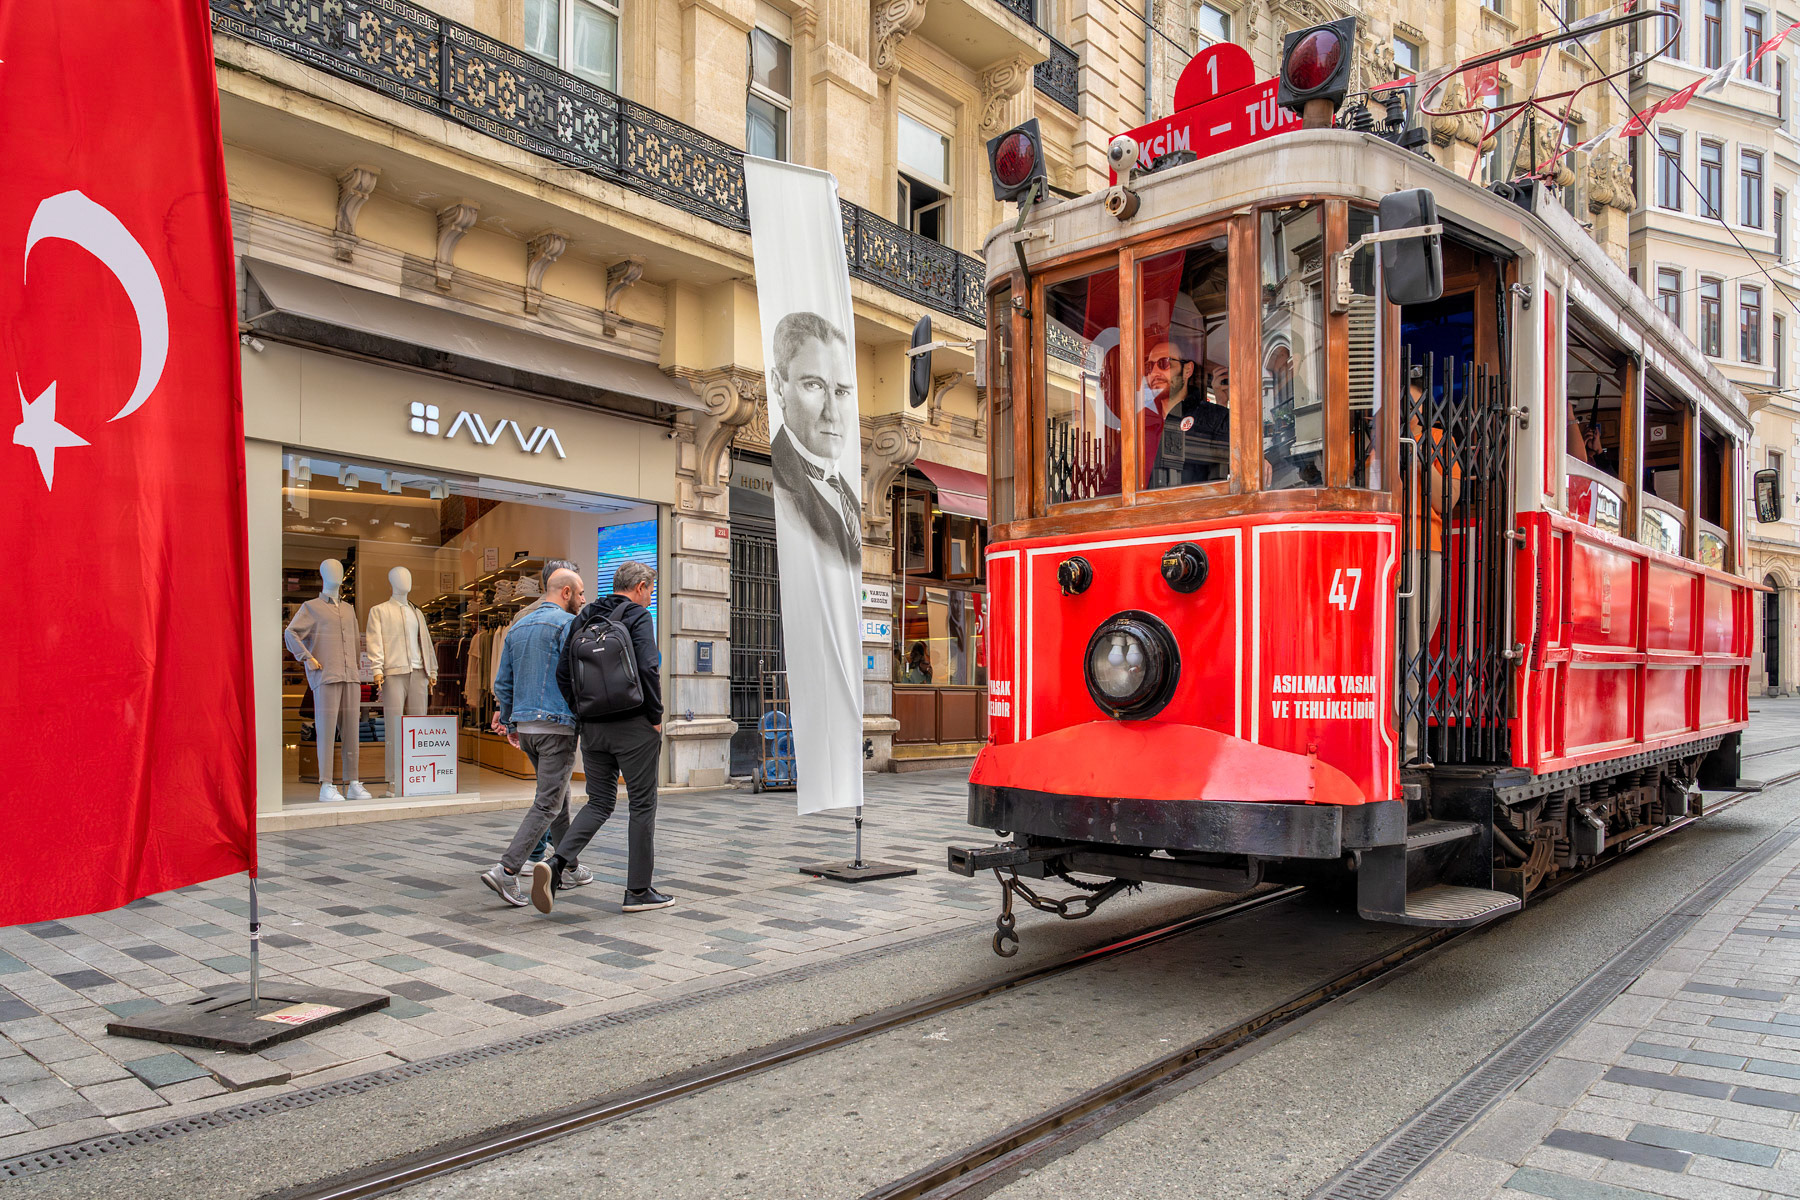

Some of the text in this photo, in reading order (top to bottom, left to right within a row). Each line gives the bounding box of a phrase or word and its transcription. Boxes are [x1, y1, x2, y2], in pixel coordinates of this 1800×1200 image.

[1206, 54, 1218, 95] 1
[1132, 123, 1190, 169] KSİM
[1246, 88, 1302, 136] TÜN
[444, 410, 567, 459] AVVA
[1329, 568, 1362, 611] 47
[1272, 675, 1376, 694] ASILMAK YASAK
[1272, 698, 1375, 719] VE TEHLİKELİDİR
[408, 728, 447, 750] 1 ALANA
[417, 740, 451, 748] BEDAVA
[408, 775, 427, 784] GET
[428, 761, 436, 783] 1
[409, 765, 428, 773] BUY
